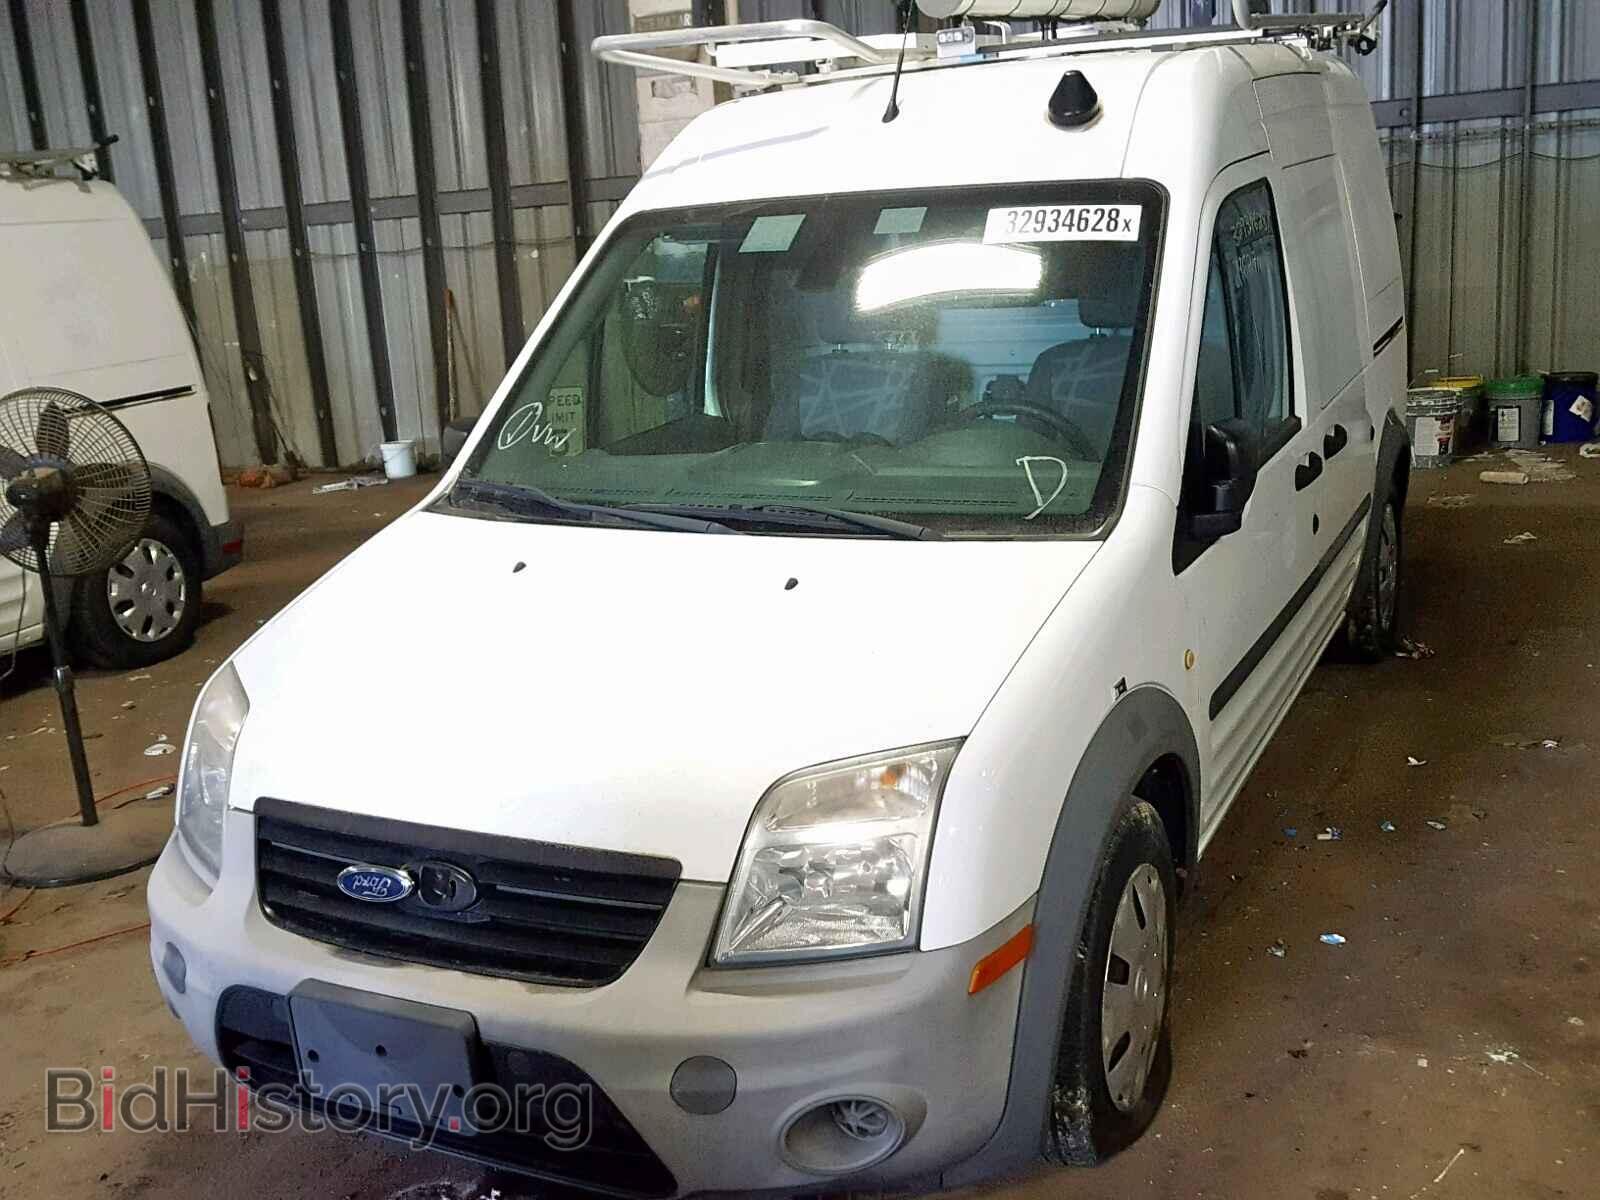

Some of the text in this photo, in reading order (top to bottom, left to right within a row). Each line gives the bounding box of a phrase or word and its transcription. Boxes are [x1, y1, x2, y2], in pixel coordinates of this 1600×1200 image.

[548, 394, 580, 406] PEED
[551, 412, 576, 424] IMIT
[352, 874, 391, 896] Ford
